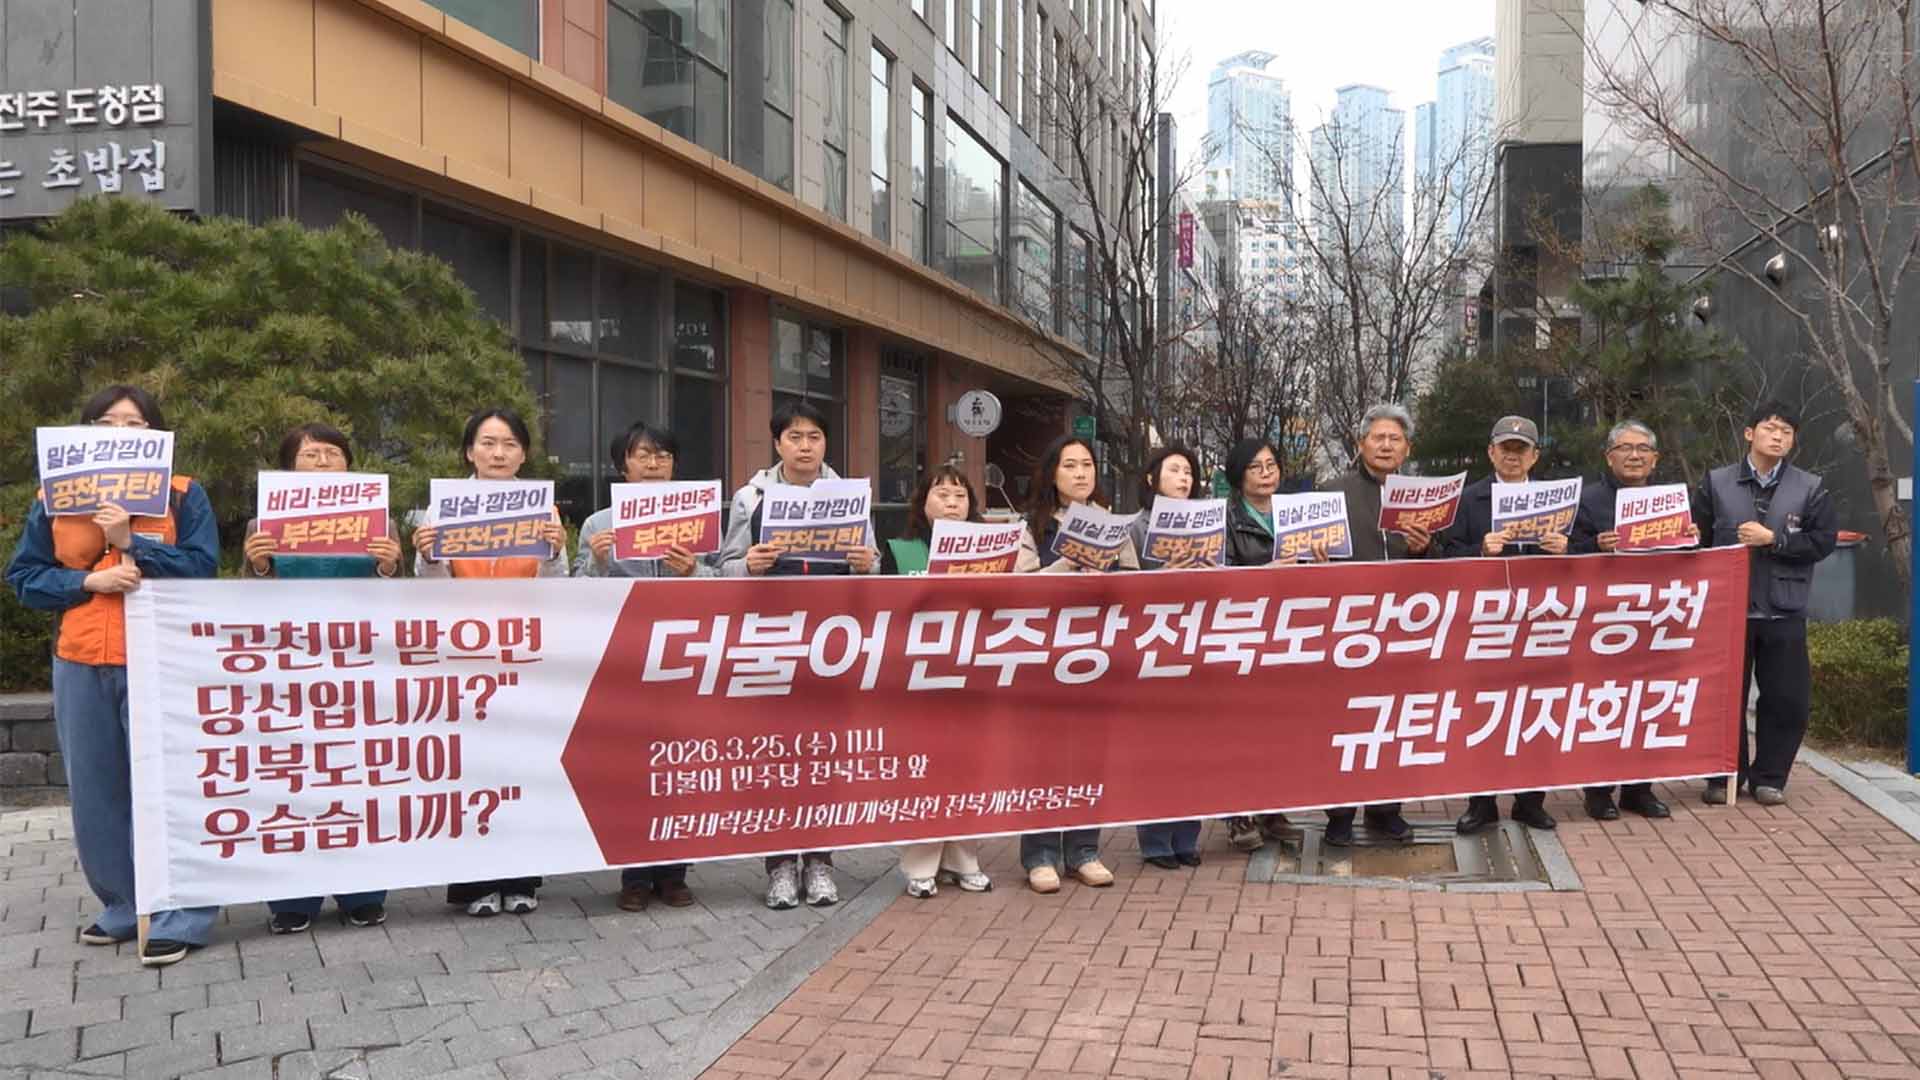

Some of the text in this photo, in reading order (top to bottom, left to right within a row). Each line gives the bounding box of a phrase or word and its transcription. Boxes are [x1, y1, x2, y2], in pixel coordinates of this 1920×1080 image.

[0, 83, 165, 129] 전주 도청점
[42, 139, 165, 193] 초밥집
[48, 438, 165, 469] 밀실·깜깜이
[52, 472, 163, 510] 공천규탄!
[267, 482, 381, 511] 비리·반민주
[440, 488, 547, 518] 밀실·깜깜이
[621, 487, 716, 520] 비리·반민주
[769, 496, 865, 519] 밀실·깜깜이
[281, 515, 369, 549] 부적격!
[632, 519, 705, 553] 부적격!
[937, 528, 1021, 555] 비리·반민주
[191, 617, 543, 673] "공천만 받으면
[641, 579, 1709, 698] 더불어 민주당 전북도당의 밀실 공천
[197, 672, 518, 736] 당선입니까?"
[1332, 678, 1700, 772] 규탄 기자회견
[196, 733, 462, 798] 전북도민이
[650, 754, 929, 797] 더불어 민주당 전북도당 앞
[946, 783, 1104, 818] 전북개헌운동본부
[200, 786, 521, 858] 우습습니까?"
